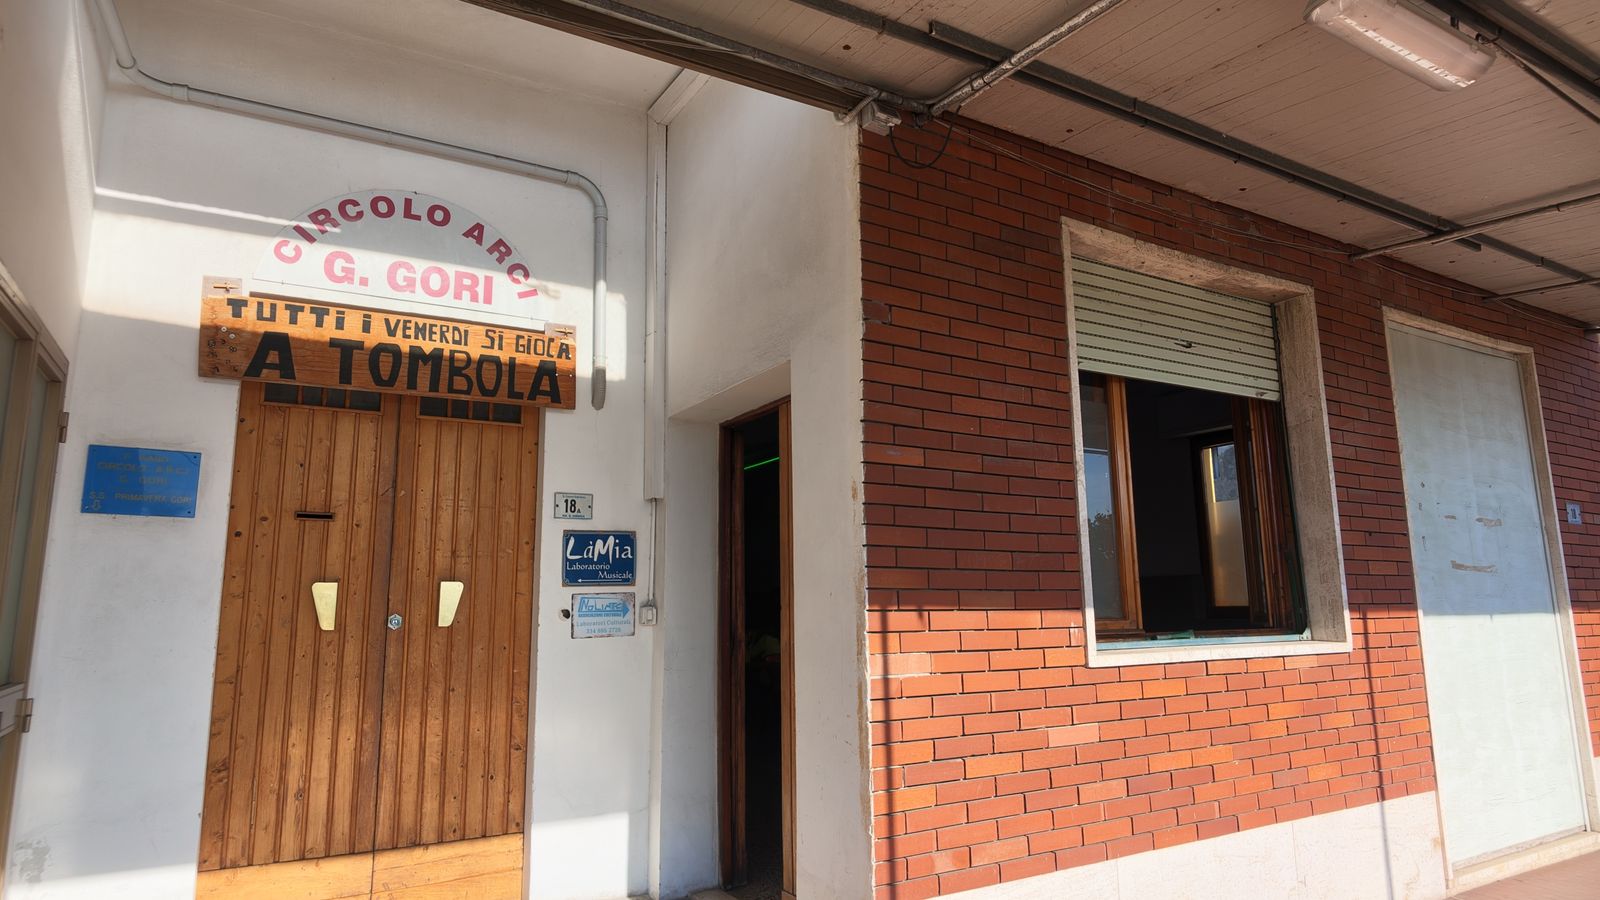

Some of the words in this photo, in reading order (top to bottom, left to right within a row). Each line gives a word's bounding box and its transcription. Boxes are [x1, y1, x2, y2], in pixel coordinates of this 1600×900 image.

[273, 195, 452, 265] CIRCOLO
[462, 221, 539, 300] ARCI
[323, 250, 369, 288] G.
[386, 260, 494, 305] GORI
[243, 331, 296, 381] A
[329, 337, 562, 405] TOMBOLA
[566, 561, 610, 571] Laboratorio
[597, 570, 633, 580] Musicale
